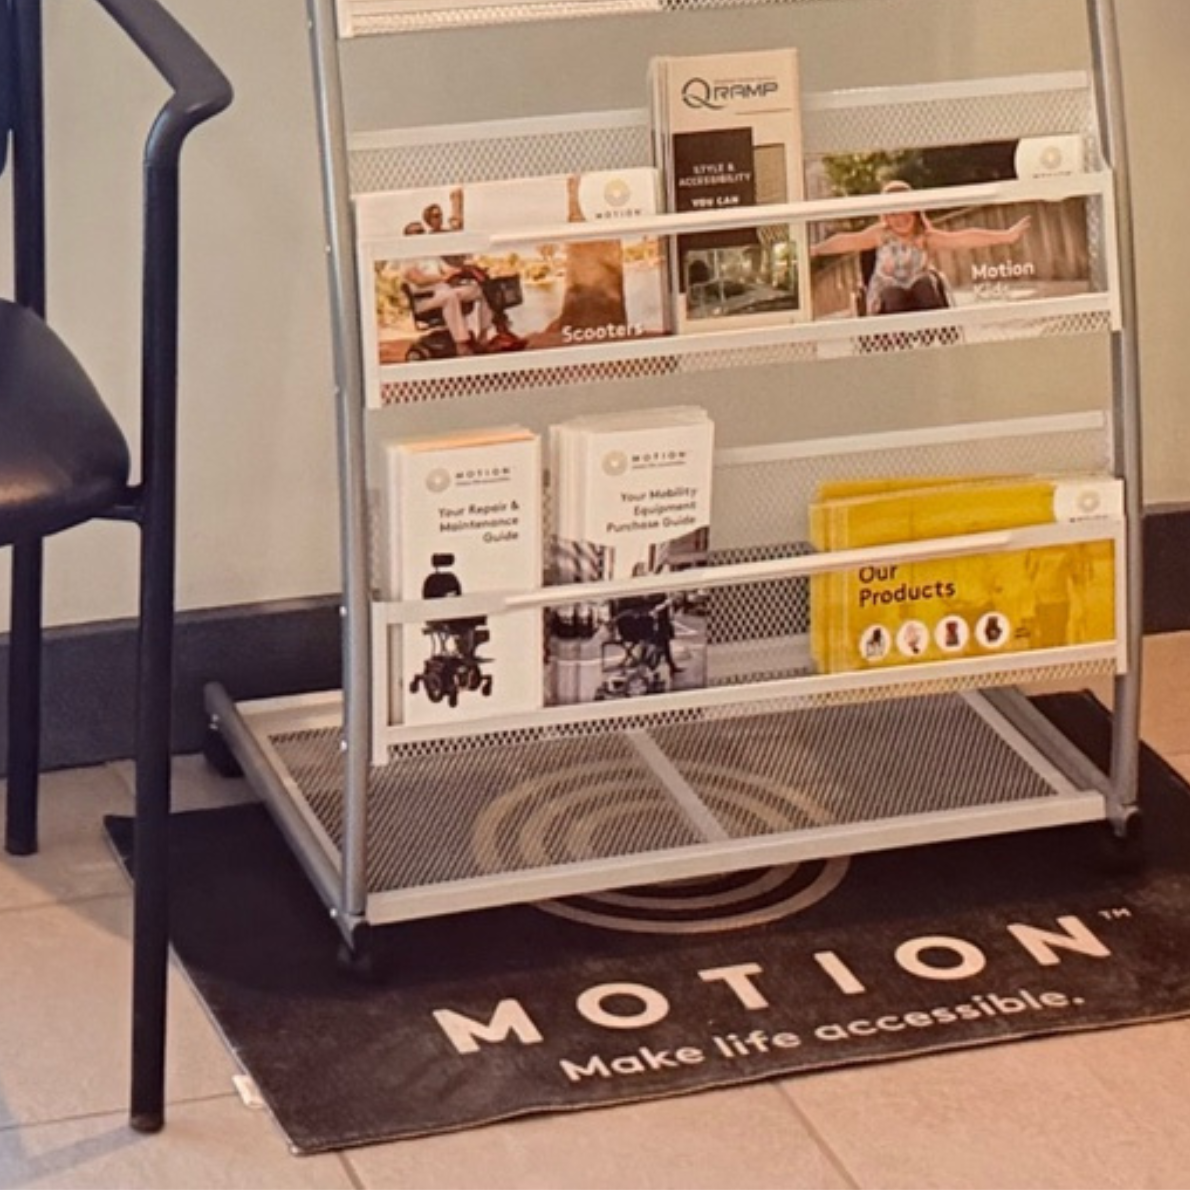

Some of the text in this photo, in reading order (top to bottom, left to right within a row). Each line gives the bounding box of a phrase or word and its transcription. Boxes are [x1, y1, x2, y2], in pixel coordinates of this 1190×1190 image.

[679, 171, 752, 187] ACCESSIBILITY
[971, 258, 1035, 281] Motion
[561, 322, 644, 344] Scooters
[631, 451, 686, 463] MOTION
[455, 466, 511, 479] MOTION
[620, 486, 698, 503] Your Mobility
[438, 498, 520, 519] Your Repair &
[633, 500, 697, 518] Equipment
[439, 516, 519, 533] Maintenance
[606, 513, 696, 533] Purchase Guide
[482, 530, 519, 545] Guide
[858, 564, 898, 585] Our
[858, 580, 957, 609] Products
[432, 914, 1112, 1054] MOTION
[559, 989, 1085, 1085] Make life accessible.
